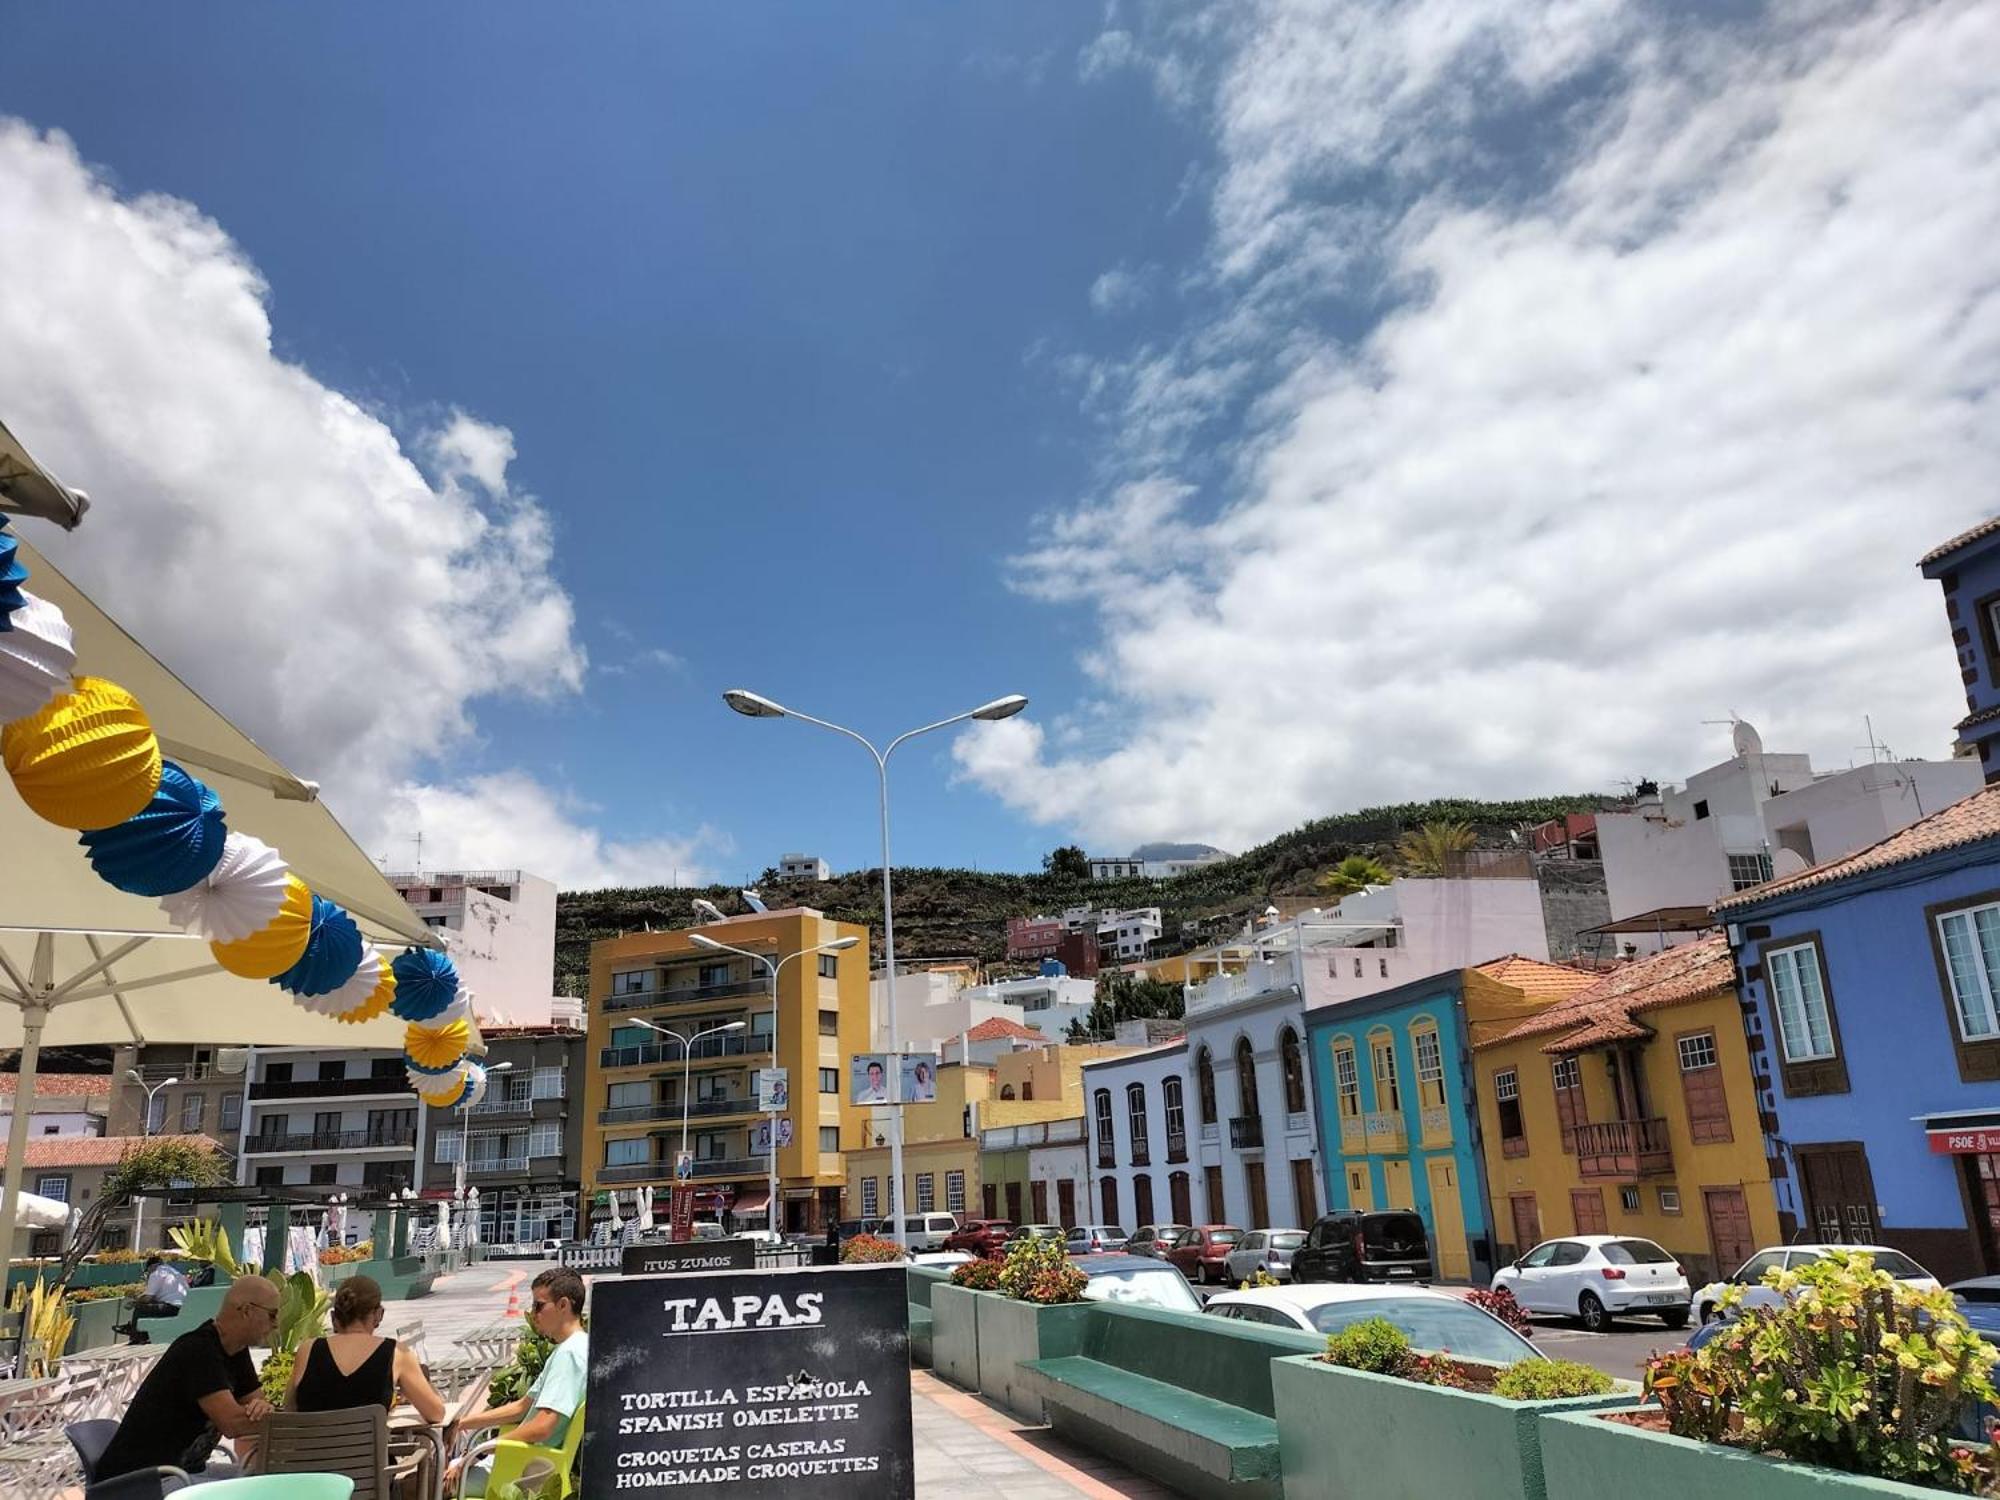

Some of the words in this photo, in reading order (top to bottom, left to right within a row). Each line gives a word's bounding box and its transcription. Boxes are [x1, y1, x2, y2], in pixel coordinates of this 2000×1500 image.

[1948, 1136, 1974, 1149] PSOE
[681, 1256, 731, 1269] ZUMOS
[664, 1293, 823, 1330] TAPAS
[621, 1389, 738, 1410] TORTILLA
[746, 1380, 871, 1402] ESPAÑOLA
[619, 1412, 724, 1434] SPANISH
[733, 1404, 859, 1427] OMELETTE
[617, 1447, 740, 1467] CROQUETAS
[747, 1439, 845, 1459] CASERAS
[616, 1468, 740, 1489] HOMEMADE
[747, 1457, 879, 1479] CROQUETTES
